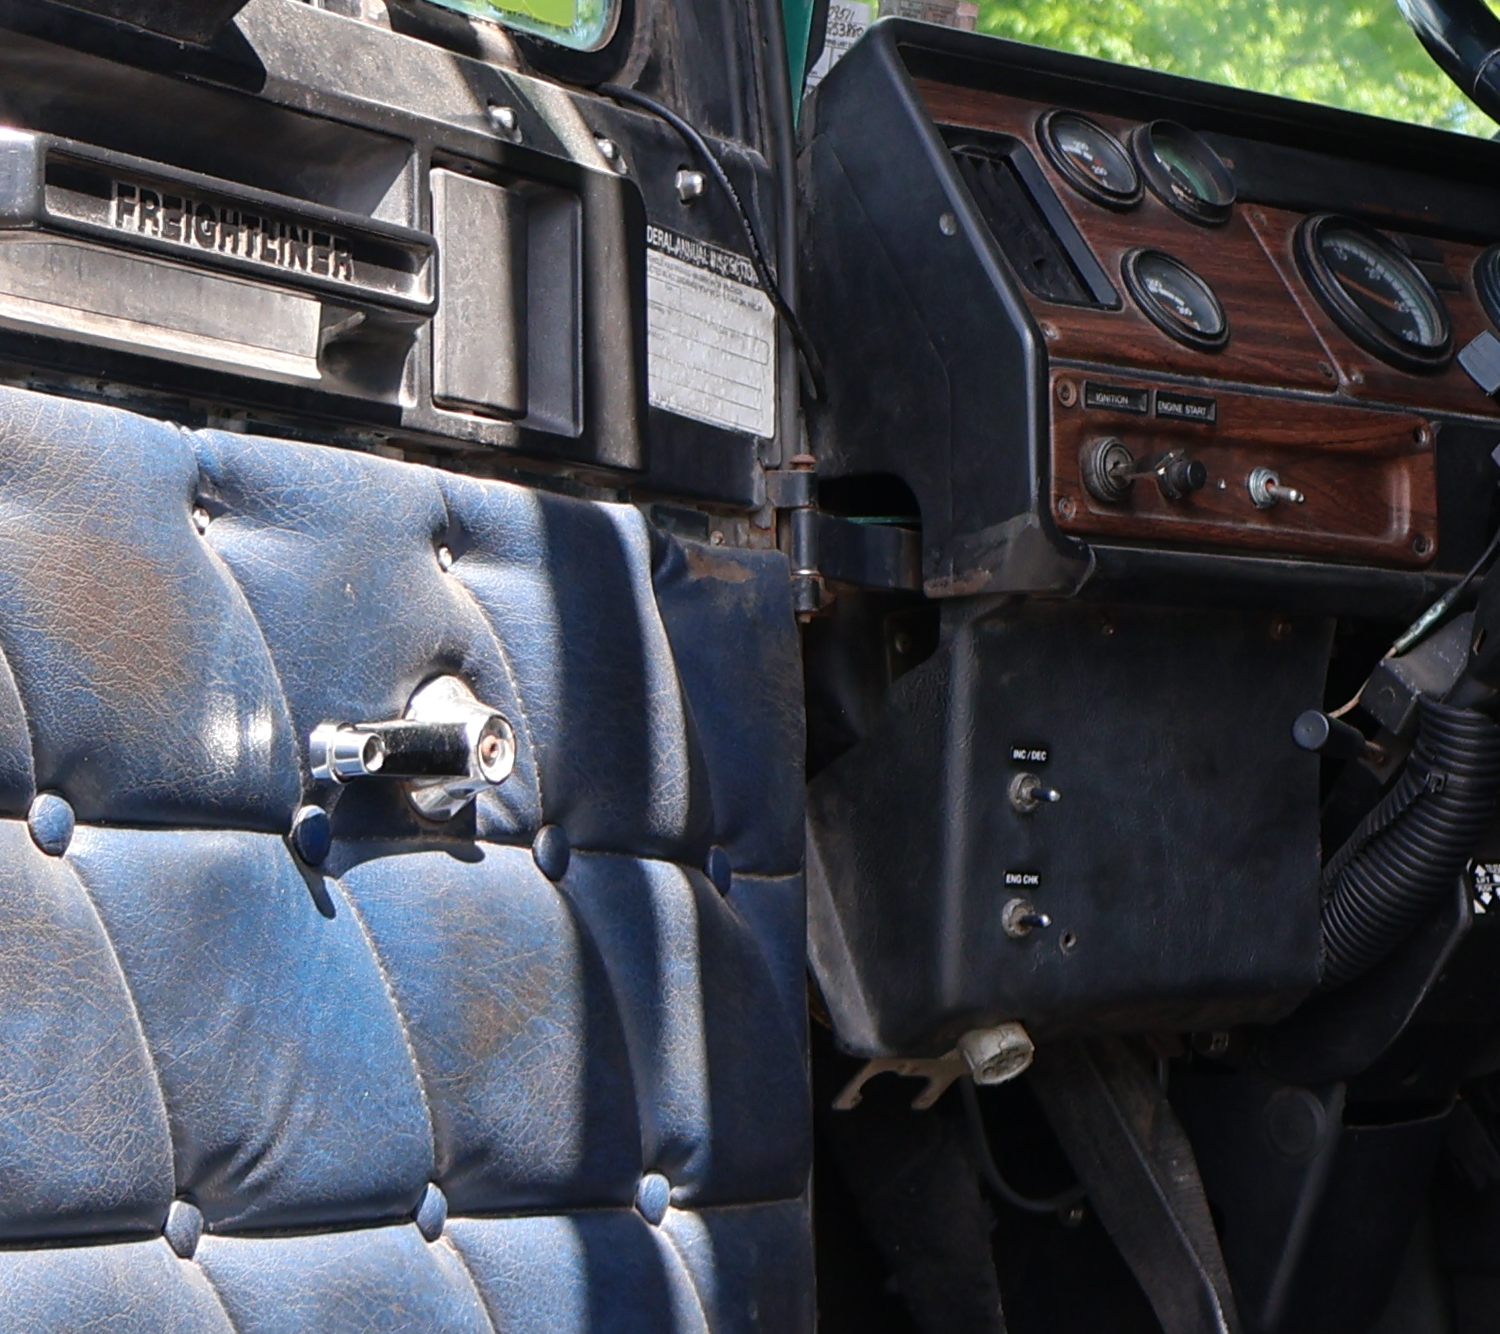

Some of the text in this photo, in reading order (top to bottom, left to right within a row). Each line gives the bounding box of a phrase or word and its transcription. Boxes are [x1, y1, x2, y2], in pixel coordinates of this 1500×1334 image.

[110, 180, 355, 282] FREIGHTLINER
[1095, 392, 1208, 416] IGNITION ENGINE START
[1005, 873, 1040, 885] ENG CHK
